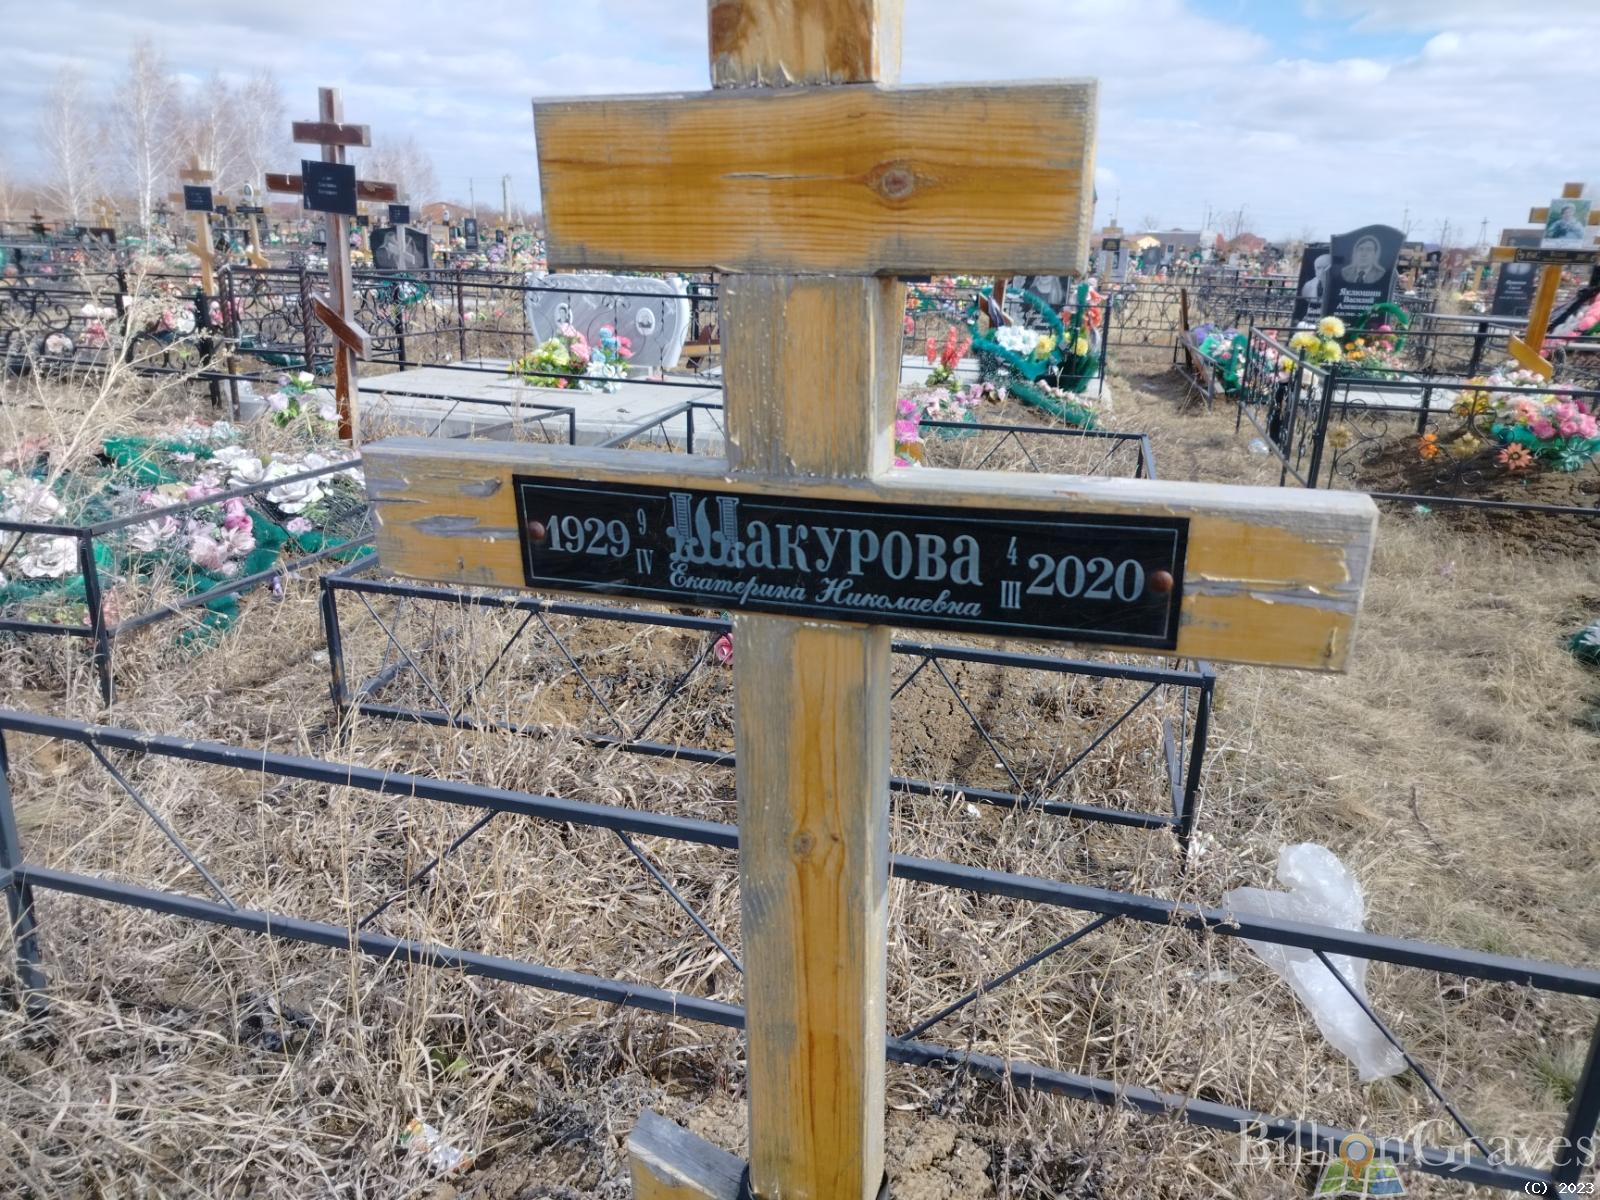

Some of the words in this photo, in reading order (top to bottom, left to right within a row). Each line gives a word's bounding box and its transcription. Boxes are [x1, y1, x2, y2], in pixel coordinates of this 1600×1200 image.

[546, 514, 631, 558] 1929
[636, 508, 647, 536] 9
[665, 491, 984, 587] Шакурова
[636, 548, 654, 575] IV
[1006, 536, 1018, 565] 4
[668, 561, 807, 605] Екатерина
[815, 577, 983, 617] Николаевна
[999, 579, 1023, 609] III
[1026, 553, 1146, 602] 2020
